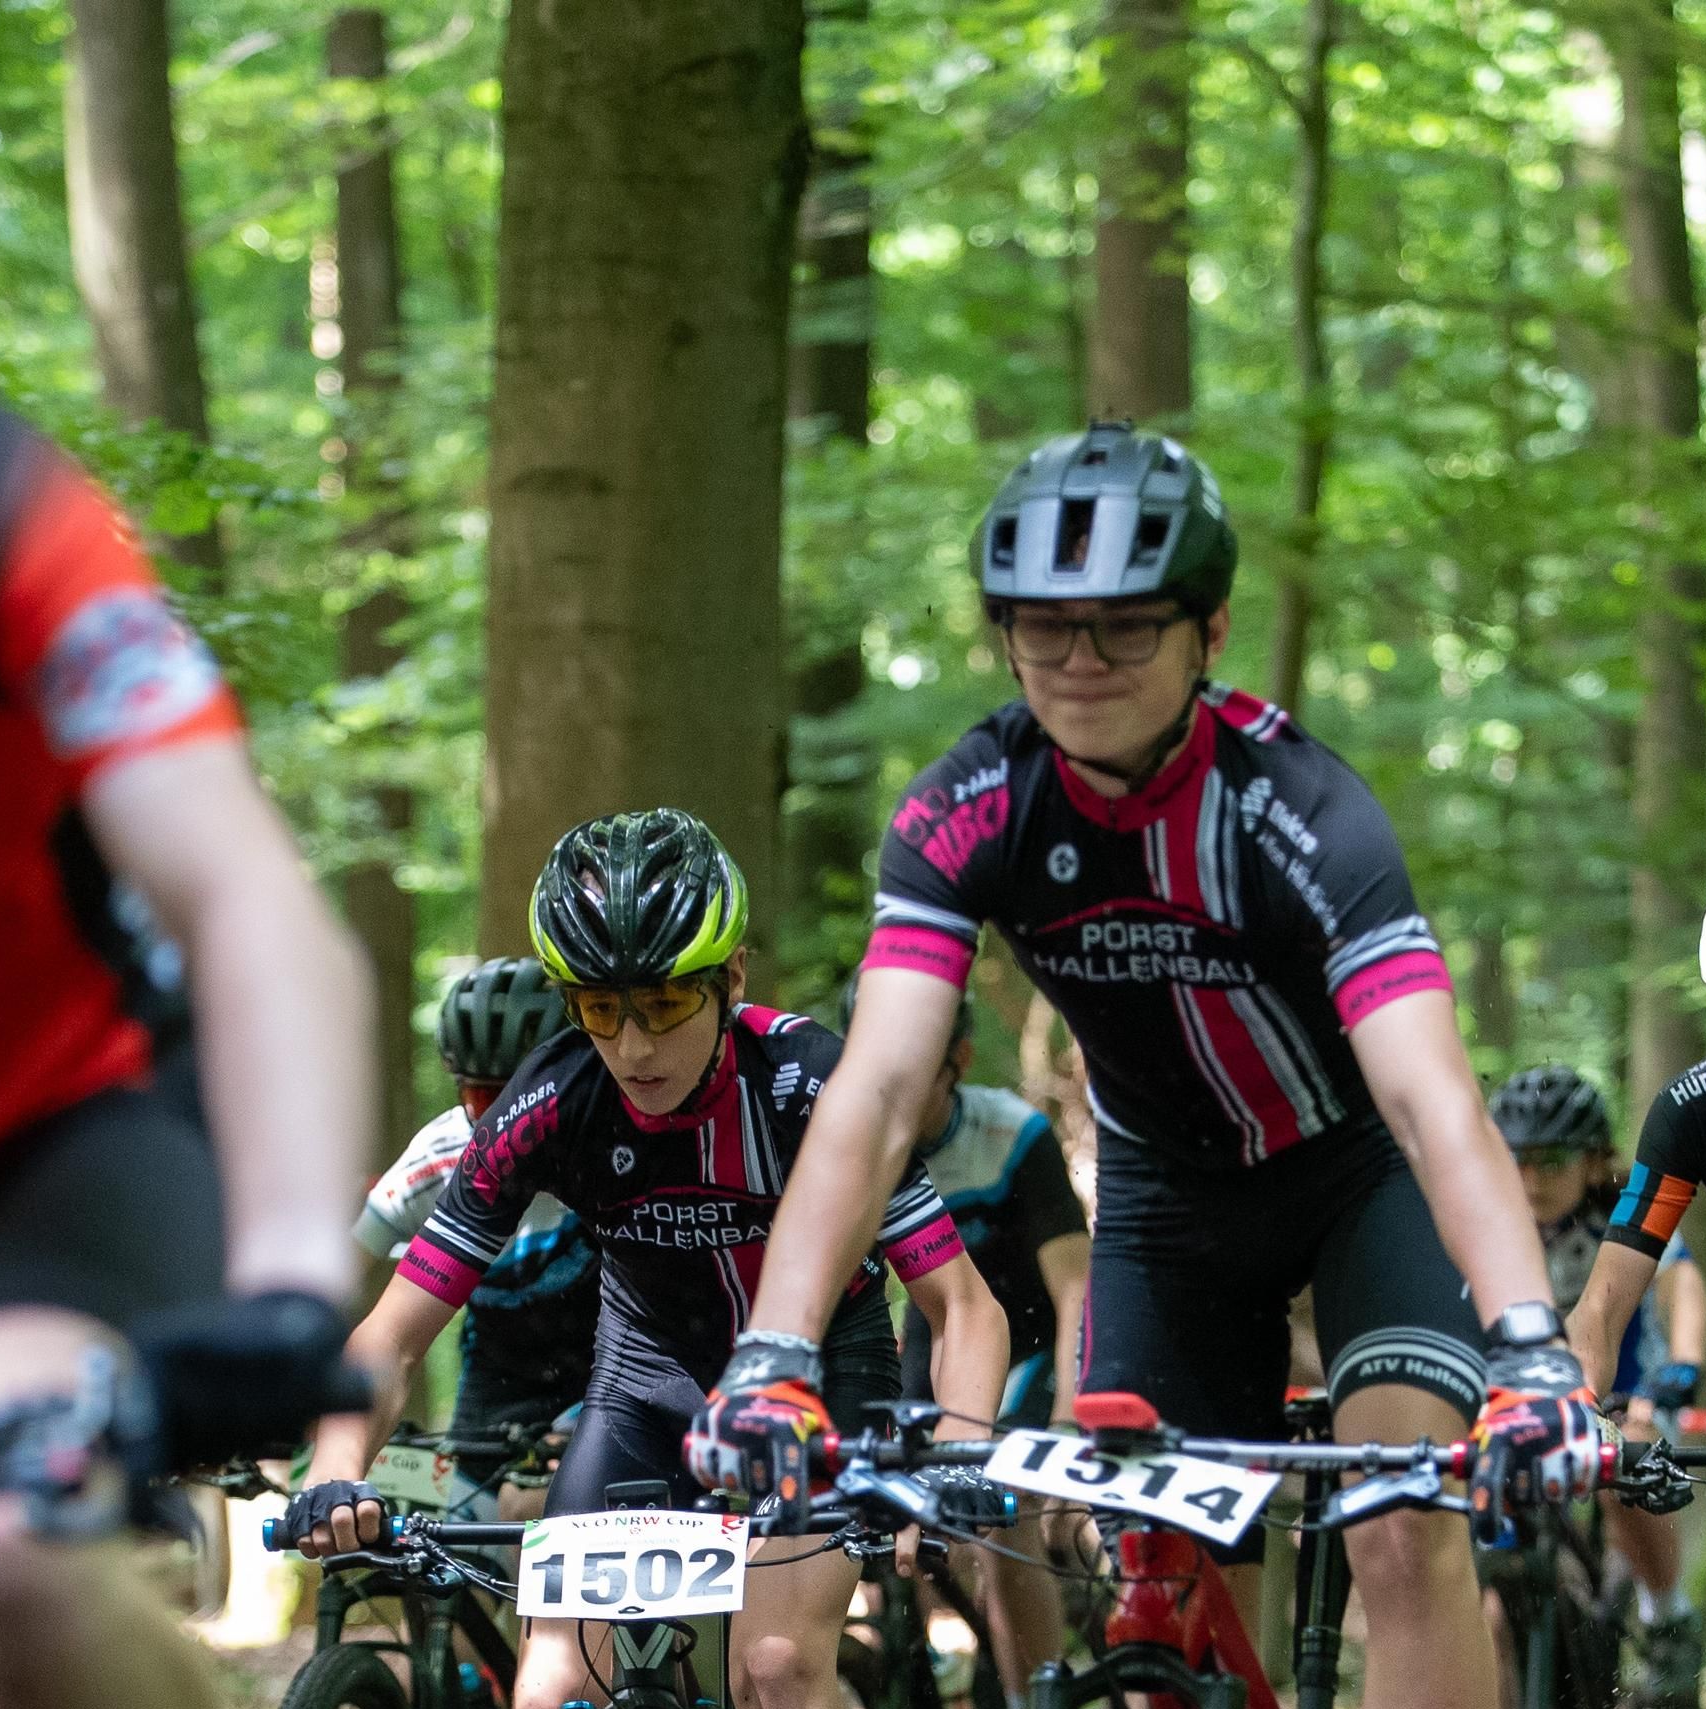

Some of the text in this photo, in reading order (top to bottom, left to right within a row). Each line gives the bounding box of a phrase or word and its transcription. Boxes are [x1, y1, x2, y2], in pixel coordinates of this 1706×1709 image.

[1081, 921, 1196, 951] PORST
[496, 1081, 556, 1133] 2-RÄDER
[633, 1202, 737, 1226] PORST
[595, 1221, 772, 1250] ALLENBA
[1359, 1357, 1401, 1377] ATV
[1021, 1437, 1244, 1525] 1514
[615, 1516, 661, 1526] NRW
[667, 1516, 704, 1528] Cup
[531, 1547, 736, 1605] 1502
